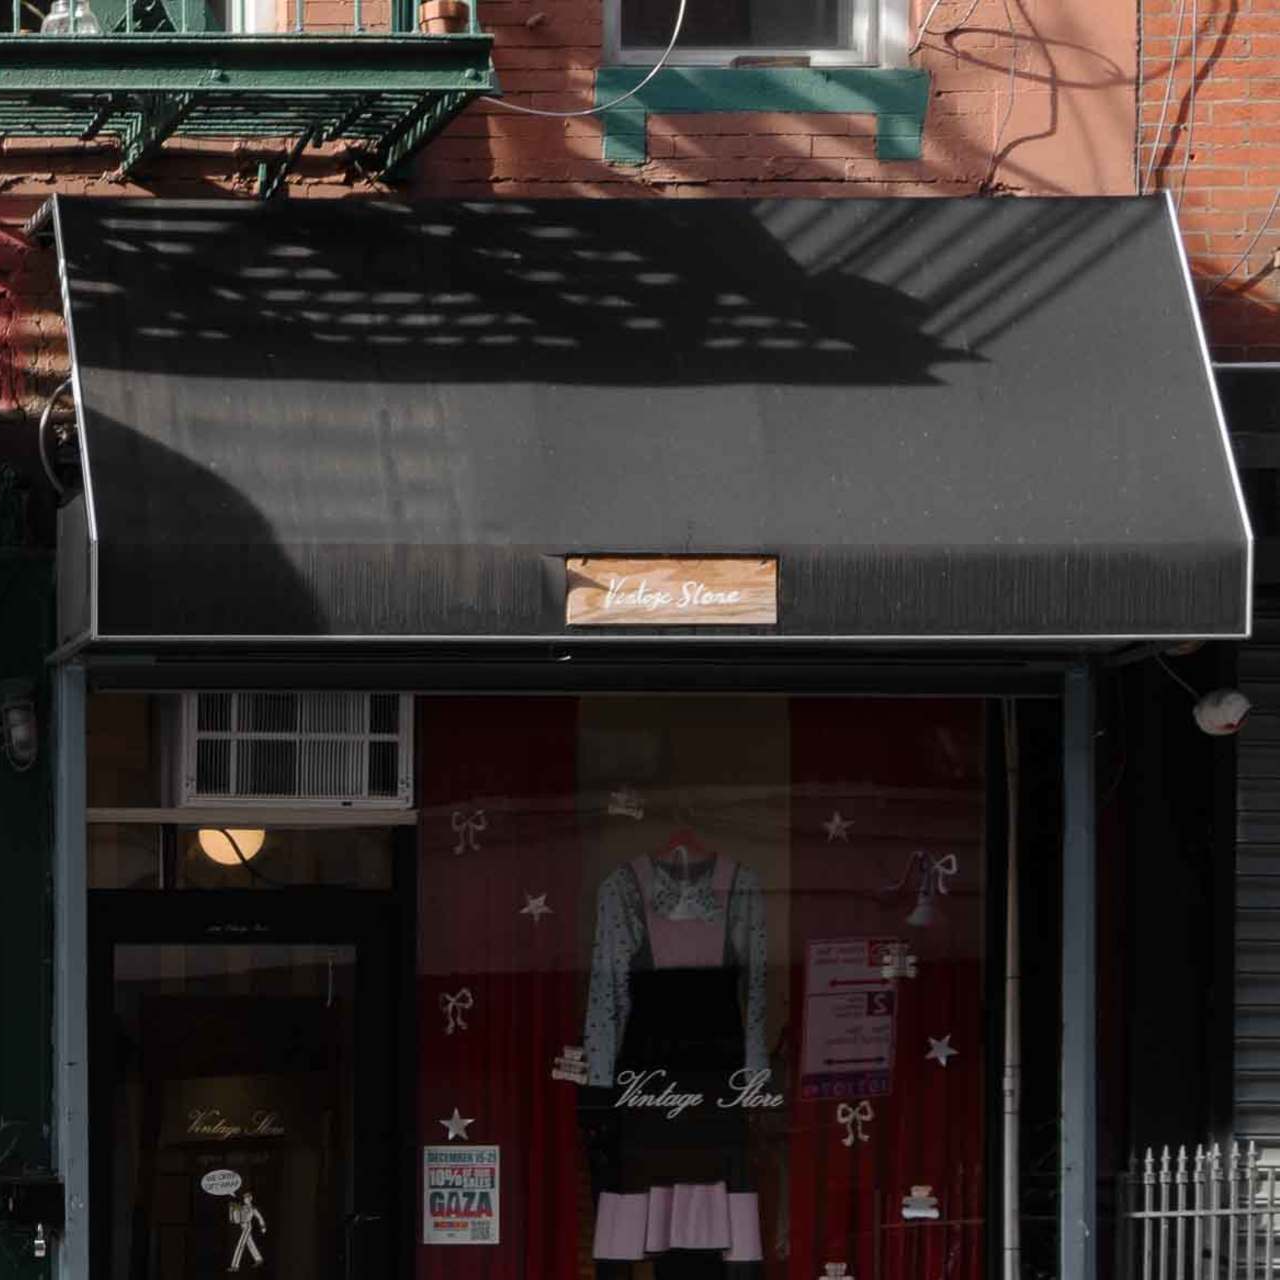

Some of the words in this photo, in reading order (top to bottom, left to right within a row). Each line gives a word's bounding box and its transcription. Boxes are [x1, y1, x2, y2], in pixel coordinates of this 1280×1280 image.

[613, 1067, 704, 1119] Vintage
[716, 1066, 785, 1109] Store
[429, 1190, 494, 1217] GAZA
